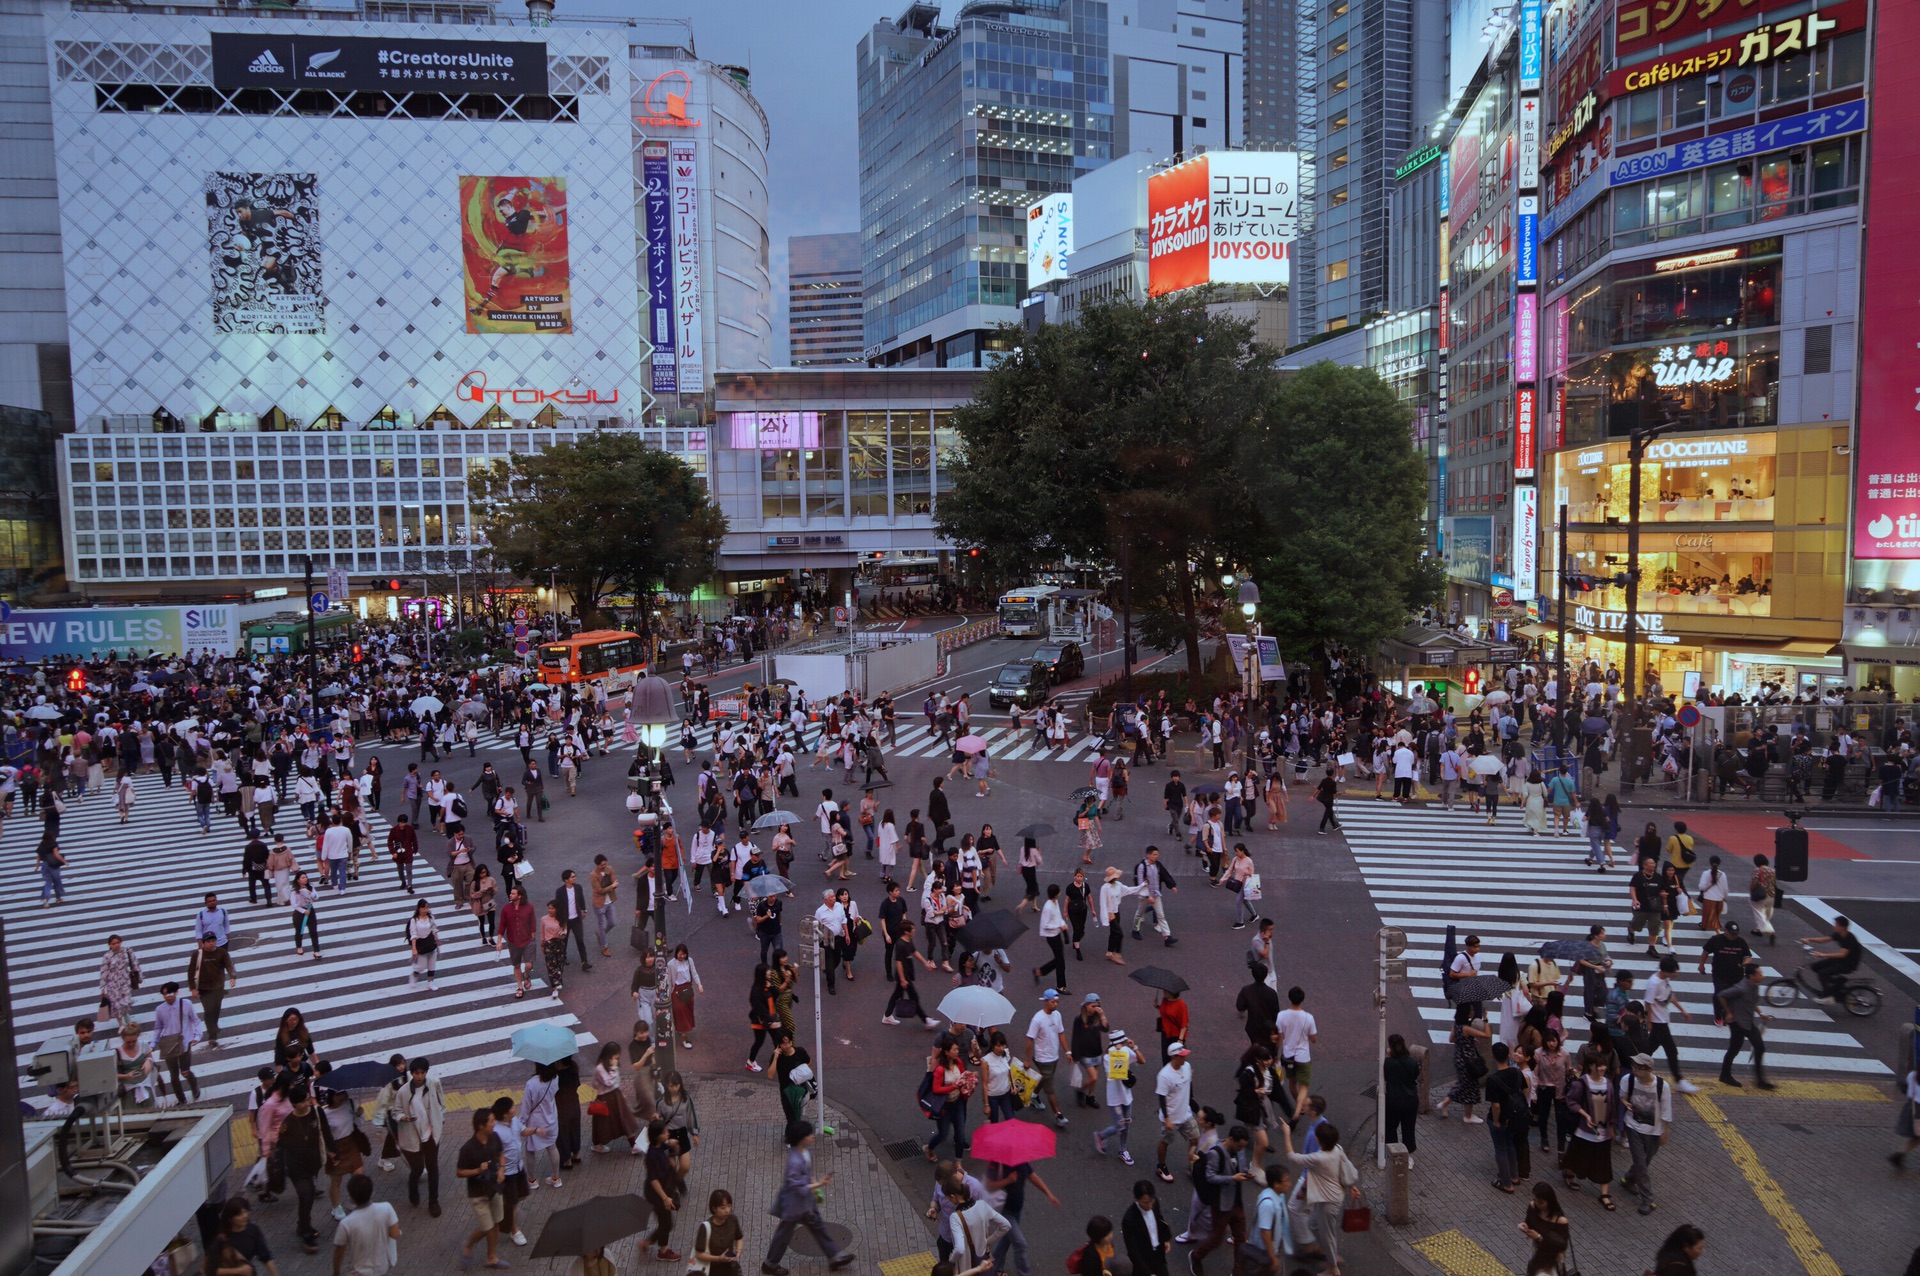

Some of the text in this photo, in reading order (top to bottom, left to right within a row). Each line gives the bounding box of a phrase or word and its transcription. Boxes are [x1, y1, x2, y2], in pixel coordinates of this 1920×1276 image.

[986, 22, 1050, 37] TOKYU PLAZA
[1739, 12, 1836, 67] ガスト
[1525, 10, 1537, 76] 東急リバブル
[249, 64, 284, 73] adidas
[378, 50, 514, 67] #CreatorsUnite
[1625, 48, 1732, 91] Caféレストラン
[379, 68, 515, 82] 予想外が世界をうめつくす。
[636, 117, 701, 127] TOKYU
[1574, 91, 1597, 137] ガスト
[1524, 120, 1534, 177] 献血ルーム
[1682, 109, 1859, 167] 英会話イーオン
[1396, 159, 1418, 177] MARK
[1419, 144, 1440, 162] CITY
[1406, 144, 1428, 161] SHIBUYA
[1617, 154, 1667, 178] AEON
[1214, 175, 1288, 195] ココロの
[1213, 197, 1297, 218] ボリューム
[1151, 198, 1207, 240] カラオケ
[1058, 201, 1071, 271] SANKYO
[1151, 225, 1208, 259] JOYSOUND
[651, 200, 666, 304] アップポイント
[676, 187, 695, 359] ワコールビッグバザール
[1521, 309, 1532, 368] 品川美容外科
[1402, 354, 1427, 368] CITY
[1658, 340, 1729, 362] 渋谷 焼肉
[1520, 371, 1532, 380] 4F
[1652, 357, 1735, 386] Ushi8
[485, 389, 618, 404] TOKYU
[1520, 391, 1532, 434] 外貨両替
[1648, 440, 1748, 459] L'OCCITANE
[1679, 459, 1729, 467] PROVENCE
[1868, 472, 1920, 485] 普通は出
[1868, 487, 1920, 499] 普通に出
[1675, 533, 1713, 550] Café
[186, 609, 226, 628] SIW
[65, 618, 172, 643] RULES.
